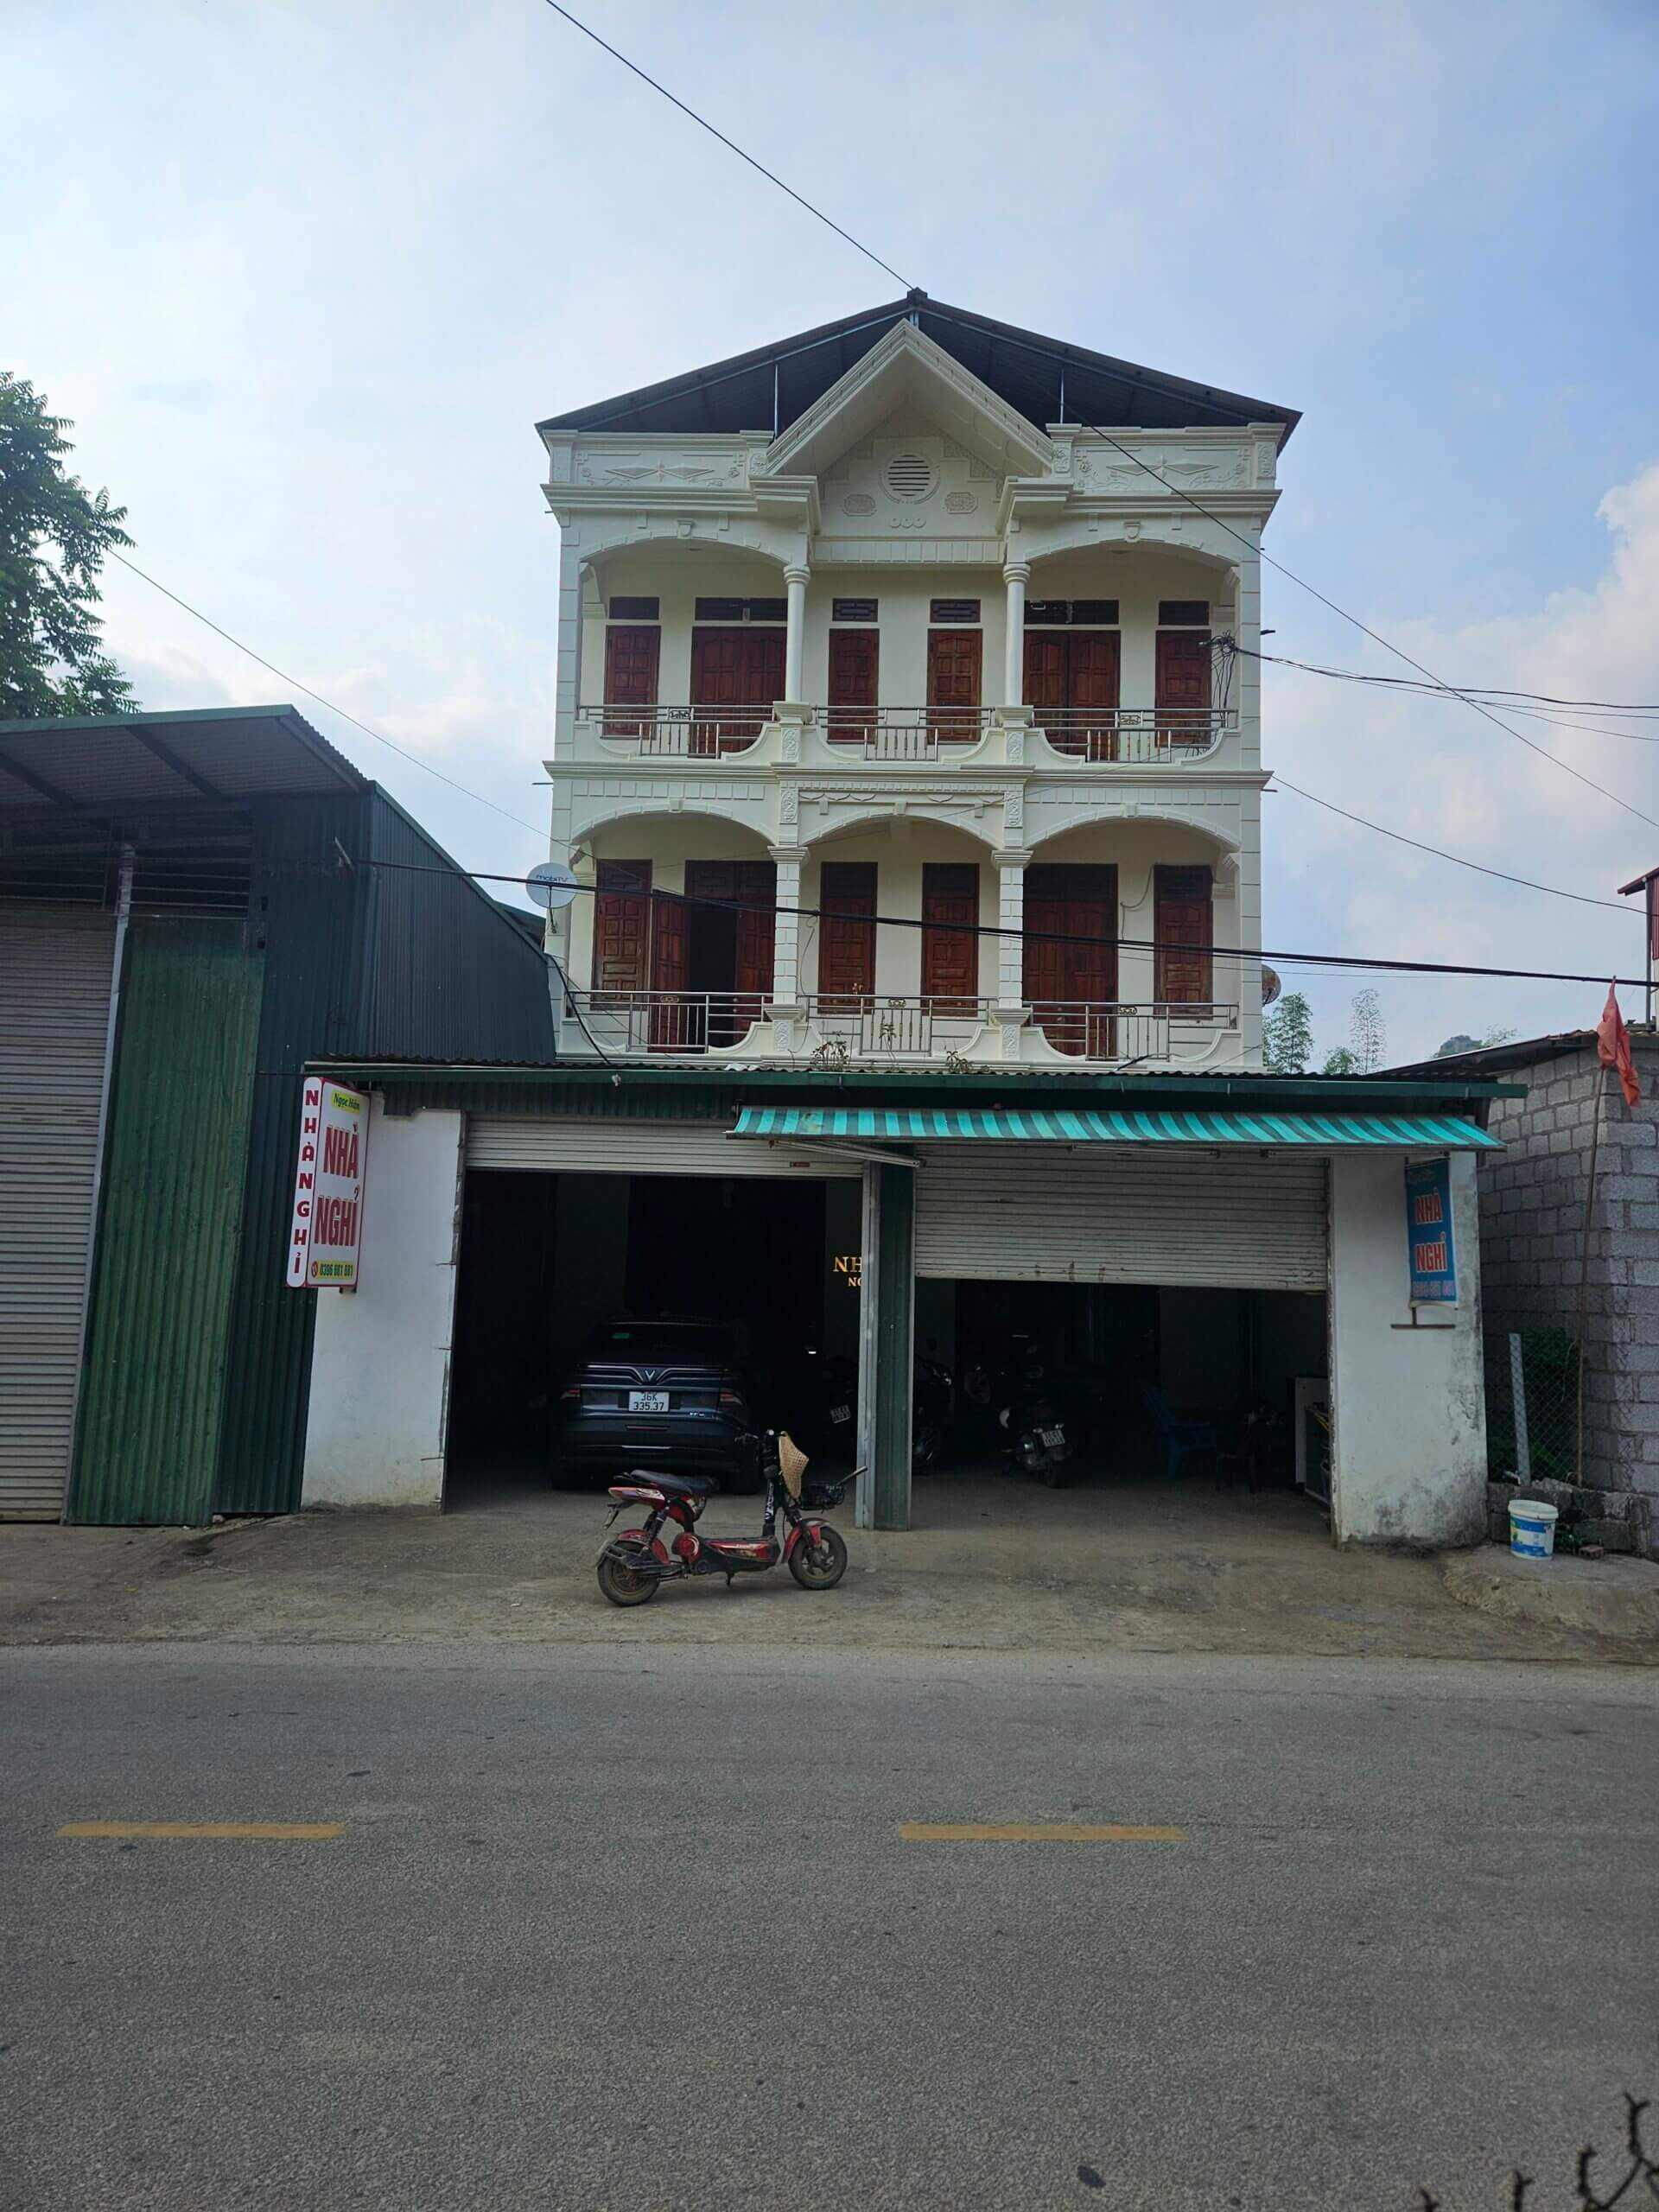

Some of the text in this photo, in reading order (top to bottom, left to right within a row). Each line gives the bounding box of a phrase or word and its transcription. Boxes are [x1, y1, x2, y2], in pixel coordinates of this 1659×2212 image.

[323, 1121, 359, 1179] NHÀ
[314, 1185, 360, 1247] NGHỈ
[633, 1402, 664, 1411] 335.37
